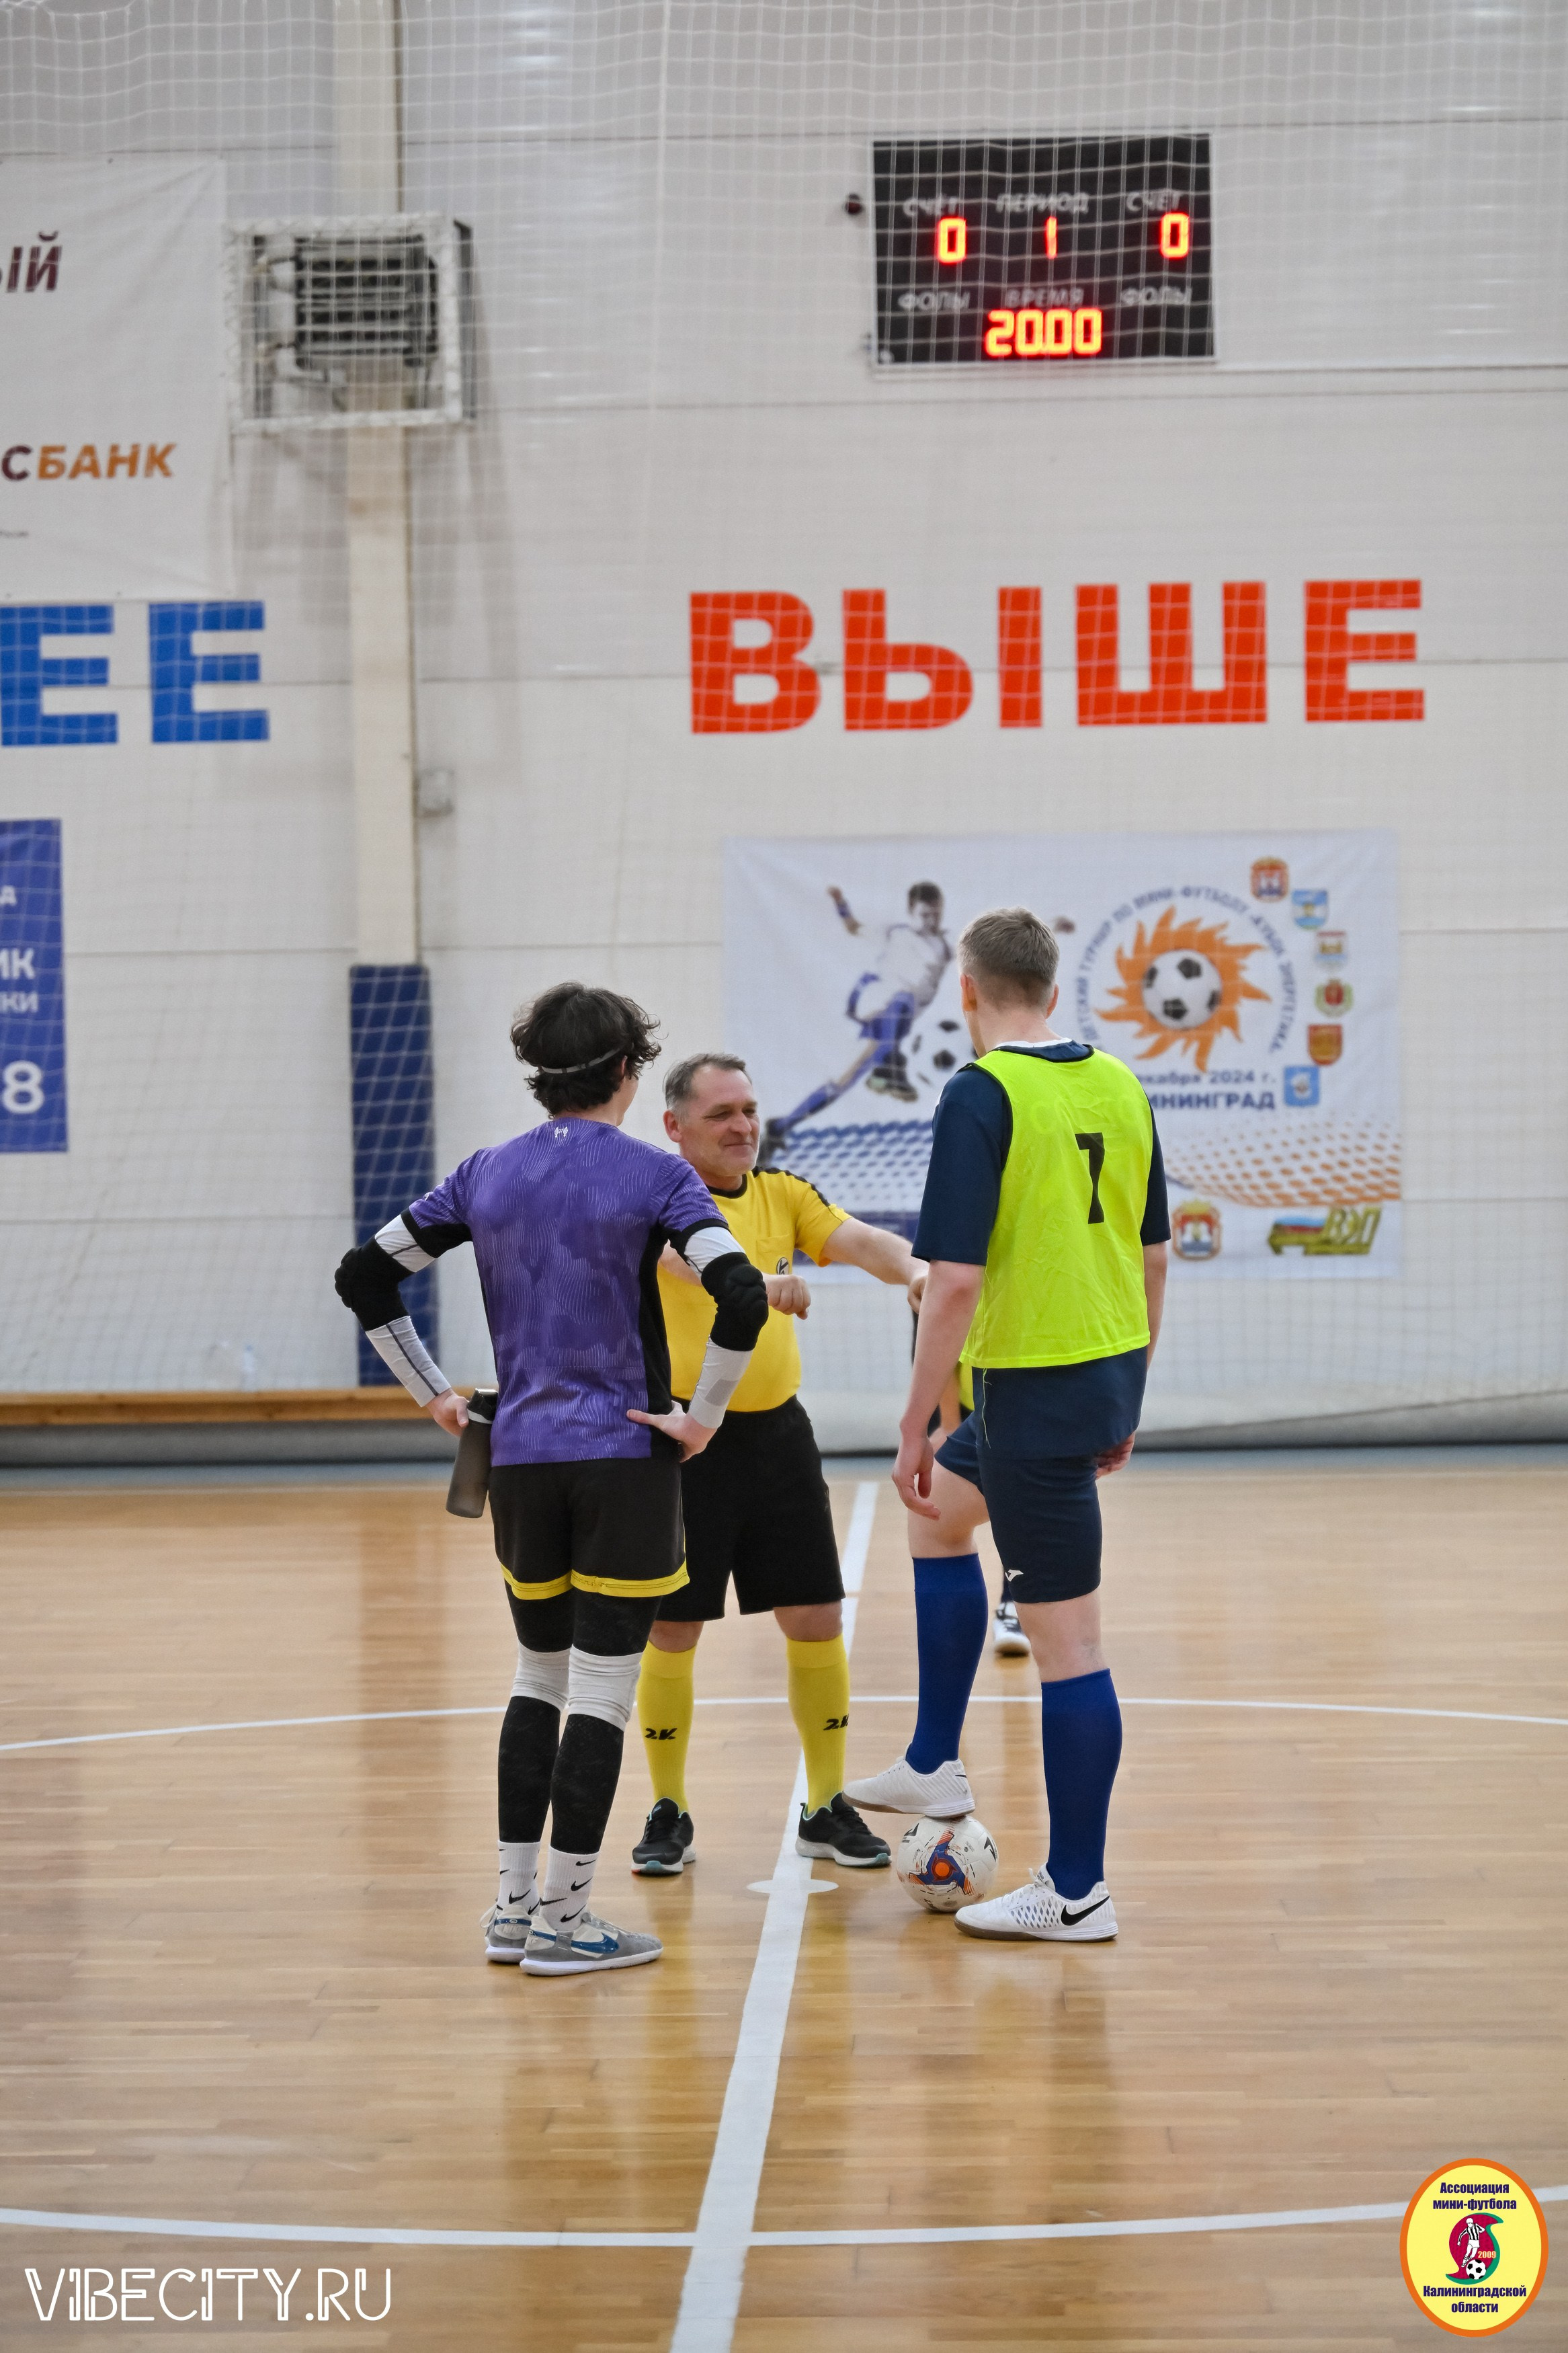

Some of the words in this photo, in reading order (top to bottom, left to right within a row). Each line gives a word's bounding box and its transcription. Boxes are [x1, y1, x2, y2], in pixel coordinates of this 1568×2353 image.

[995, 192, 1088, 214] ПЕРИОД
[936, 216, 966, 263] 0
[1045, 216, 1057, 260] 1
[1160, 212, 1189, 258] 0
[1005, 287, 1084, 308] ВРЕМЯ
[1, 444, 176, 481] СБАНК
[0, 601, 270, 746] ЕЕ
[690, 580, 1425, 734] ВЫШЕ
